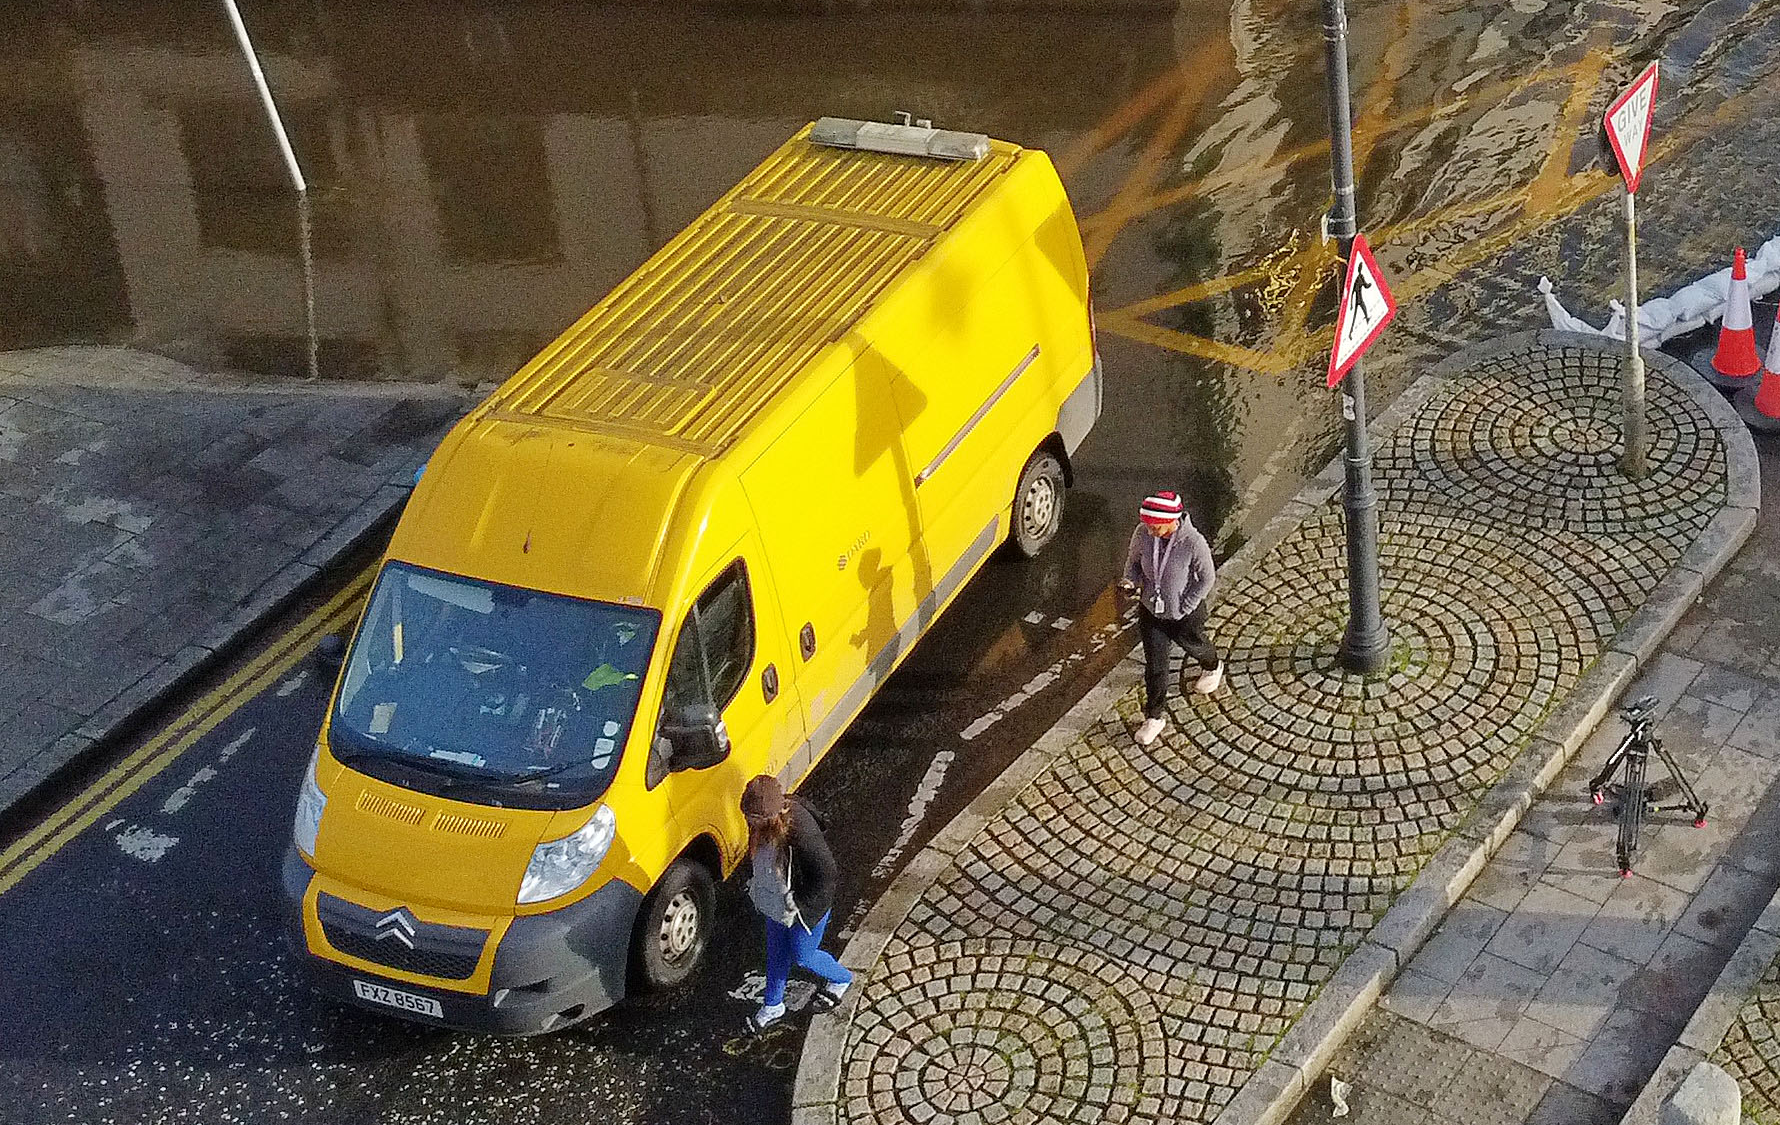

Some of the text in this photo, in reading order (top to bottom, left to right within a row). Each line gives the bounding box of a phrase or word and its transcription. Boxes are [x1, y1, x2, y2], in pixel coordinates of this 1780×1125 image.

[1617, 87, 1648, 133] GIVE
[1623, 117, 1644, 147] WAY
[360, 983, 435, 1014] FXZ 8567
